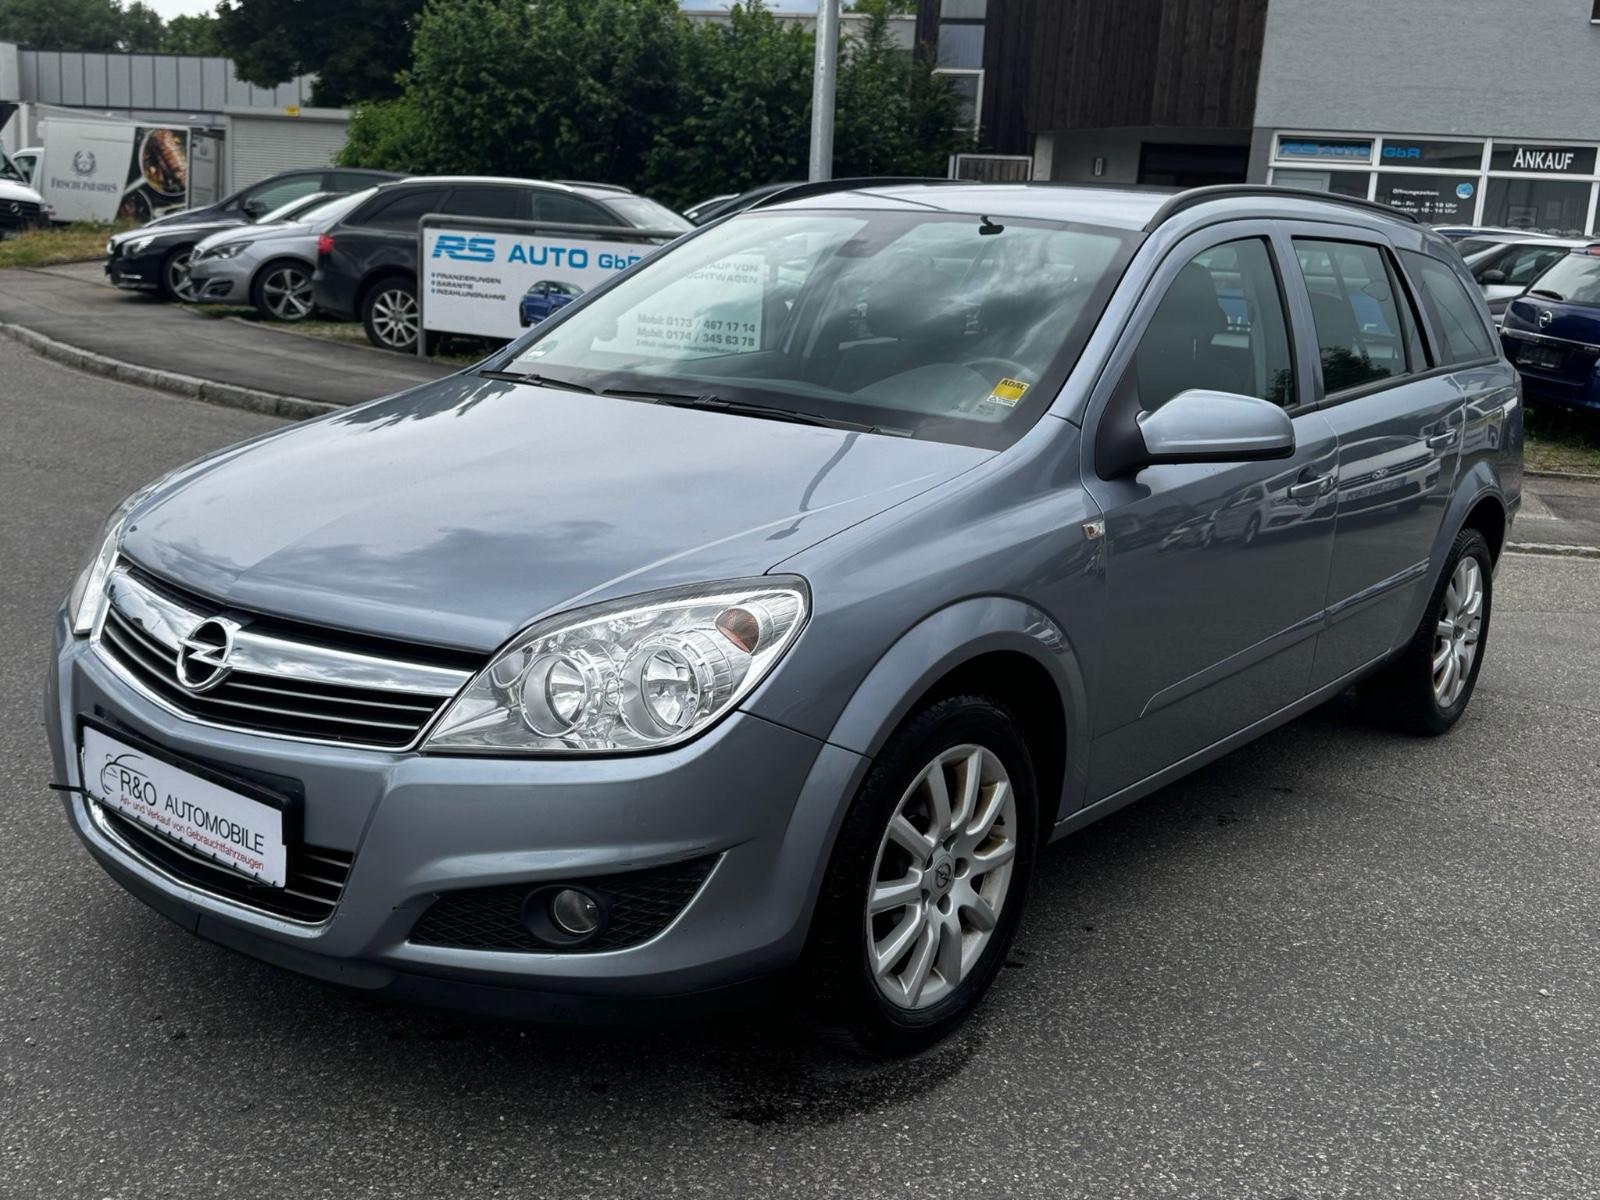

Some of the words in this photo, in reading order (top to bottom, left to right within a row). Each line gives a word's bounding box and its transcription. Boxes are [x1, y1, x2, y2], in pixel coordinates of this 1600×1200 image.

[1382, 146, 1421, 158] GbR
[1512, 147, 1575, 170] ANKAUF
[432, 235, 496, 263] RS
[508, 244, 588, 269] AUTO
[734, 263, 759, 273] VON
[666, 316, 693, 328] 0173
[703, 320, 723, 330] 467
[726, 321, 740, 331] 17
[742, 323, 756, 333] 14
[665, 330, 692, 341] 0174
[703, 333, 722, 344] 345
[725, 335, 739, 345] 63
[1000, 379, 1027, 391] ADAC
[120, 769, 157, 806] R&O
[165, 794, 264, 856] AUTOMOBILE
[133, 801, 146, 814] und
[147, 807, 171, 826] Verkauf
[172, 822, 186, 835] von
[186, 826, 264, 871] Gebrauchtfahrzeugen
